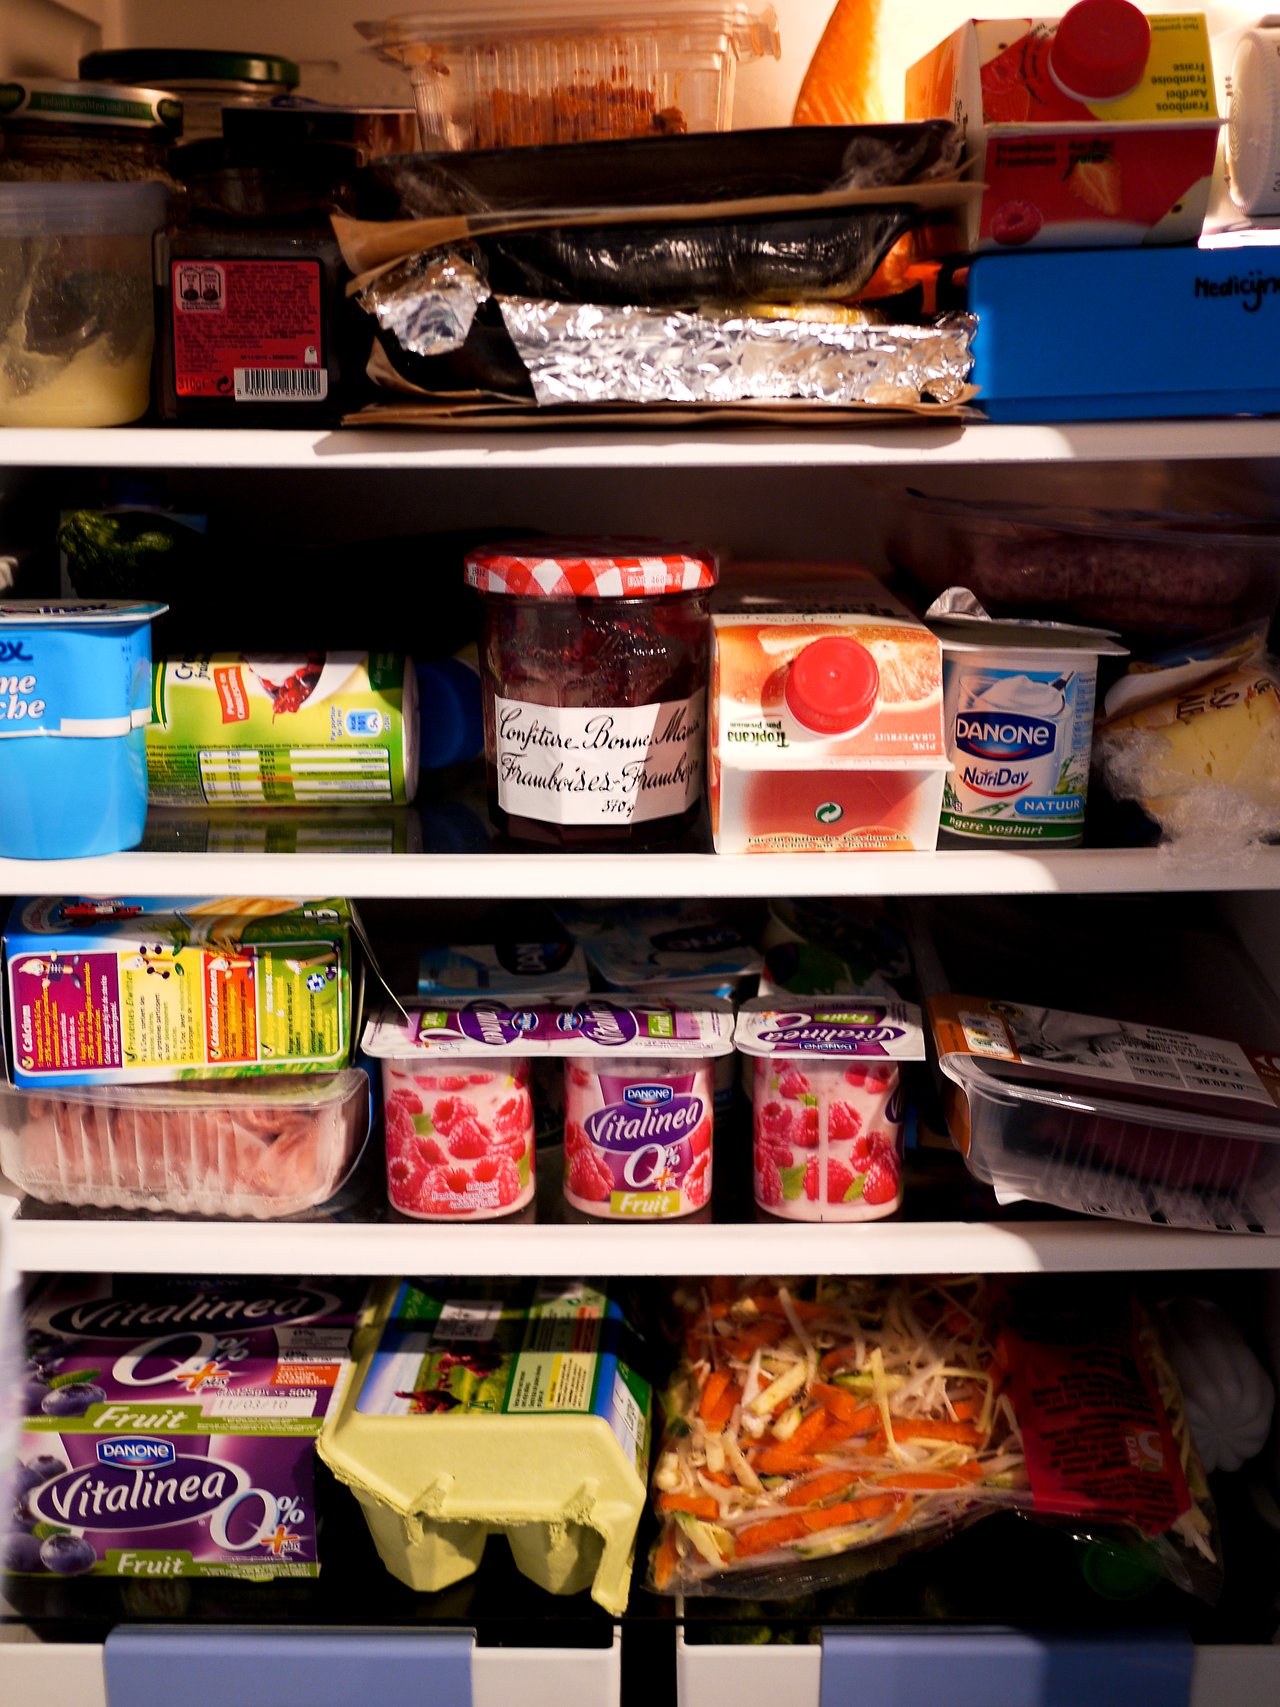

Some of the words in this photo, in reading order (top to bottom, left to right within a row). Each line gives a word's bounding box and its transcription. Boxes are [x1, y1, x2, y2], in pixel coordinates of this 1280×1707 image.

[1173, 63, 1205, 72] Fraise
[1151, 75, 1206, 86] Framboise
[1166, 89, 1207, 101] Aardbei
[1156, 101, 1209, 113] Framboos
[499, 707, 579, 751] Confiture
[582, 714, 652, 749] Bonne
[957, 718, 1050, 746] DANONE
[728, 730, 790, 748] Tropicana
[874, 733, 936, 742] GRAPEFRUIT
[912, 742, 936, 751] PINK
[963, 767, 1029, 787] NutriDay
[1024, 800, 1080, 812] NATUUR
[987, 824, 1044, 835] yoghurt
[822, 1013, 868, 1024] Fruit
[22, 1005, 34, 1053] Calcium
[767, 1028, 895, 1043] Vitalinea
[628, 1089, 670, 1099] DANONE
[591, 1101, 699, 1142] Vitalinea
[620, 1193, 672, 1213] Fruit
[71, 1293, 314, 1331] Vitalinea
[93, 1405, 188, 1430] Fruit
[103, 1443, 170, 1458] DANONE
[51, 1470, 227, 1521] Vitalinea
[117, 1552, 185, 1576] Fruit
